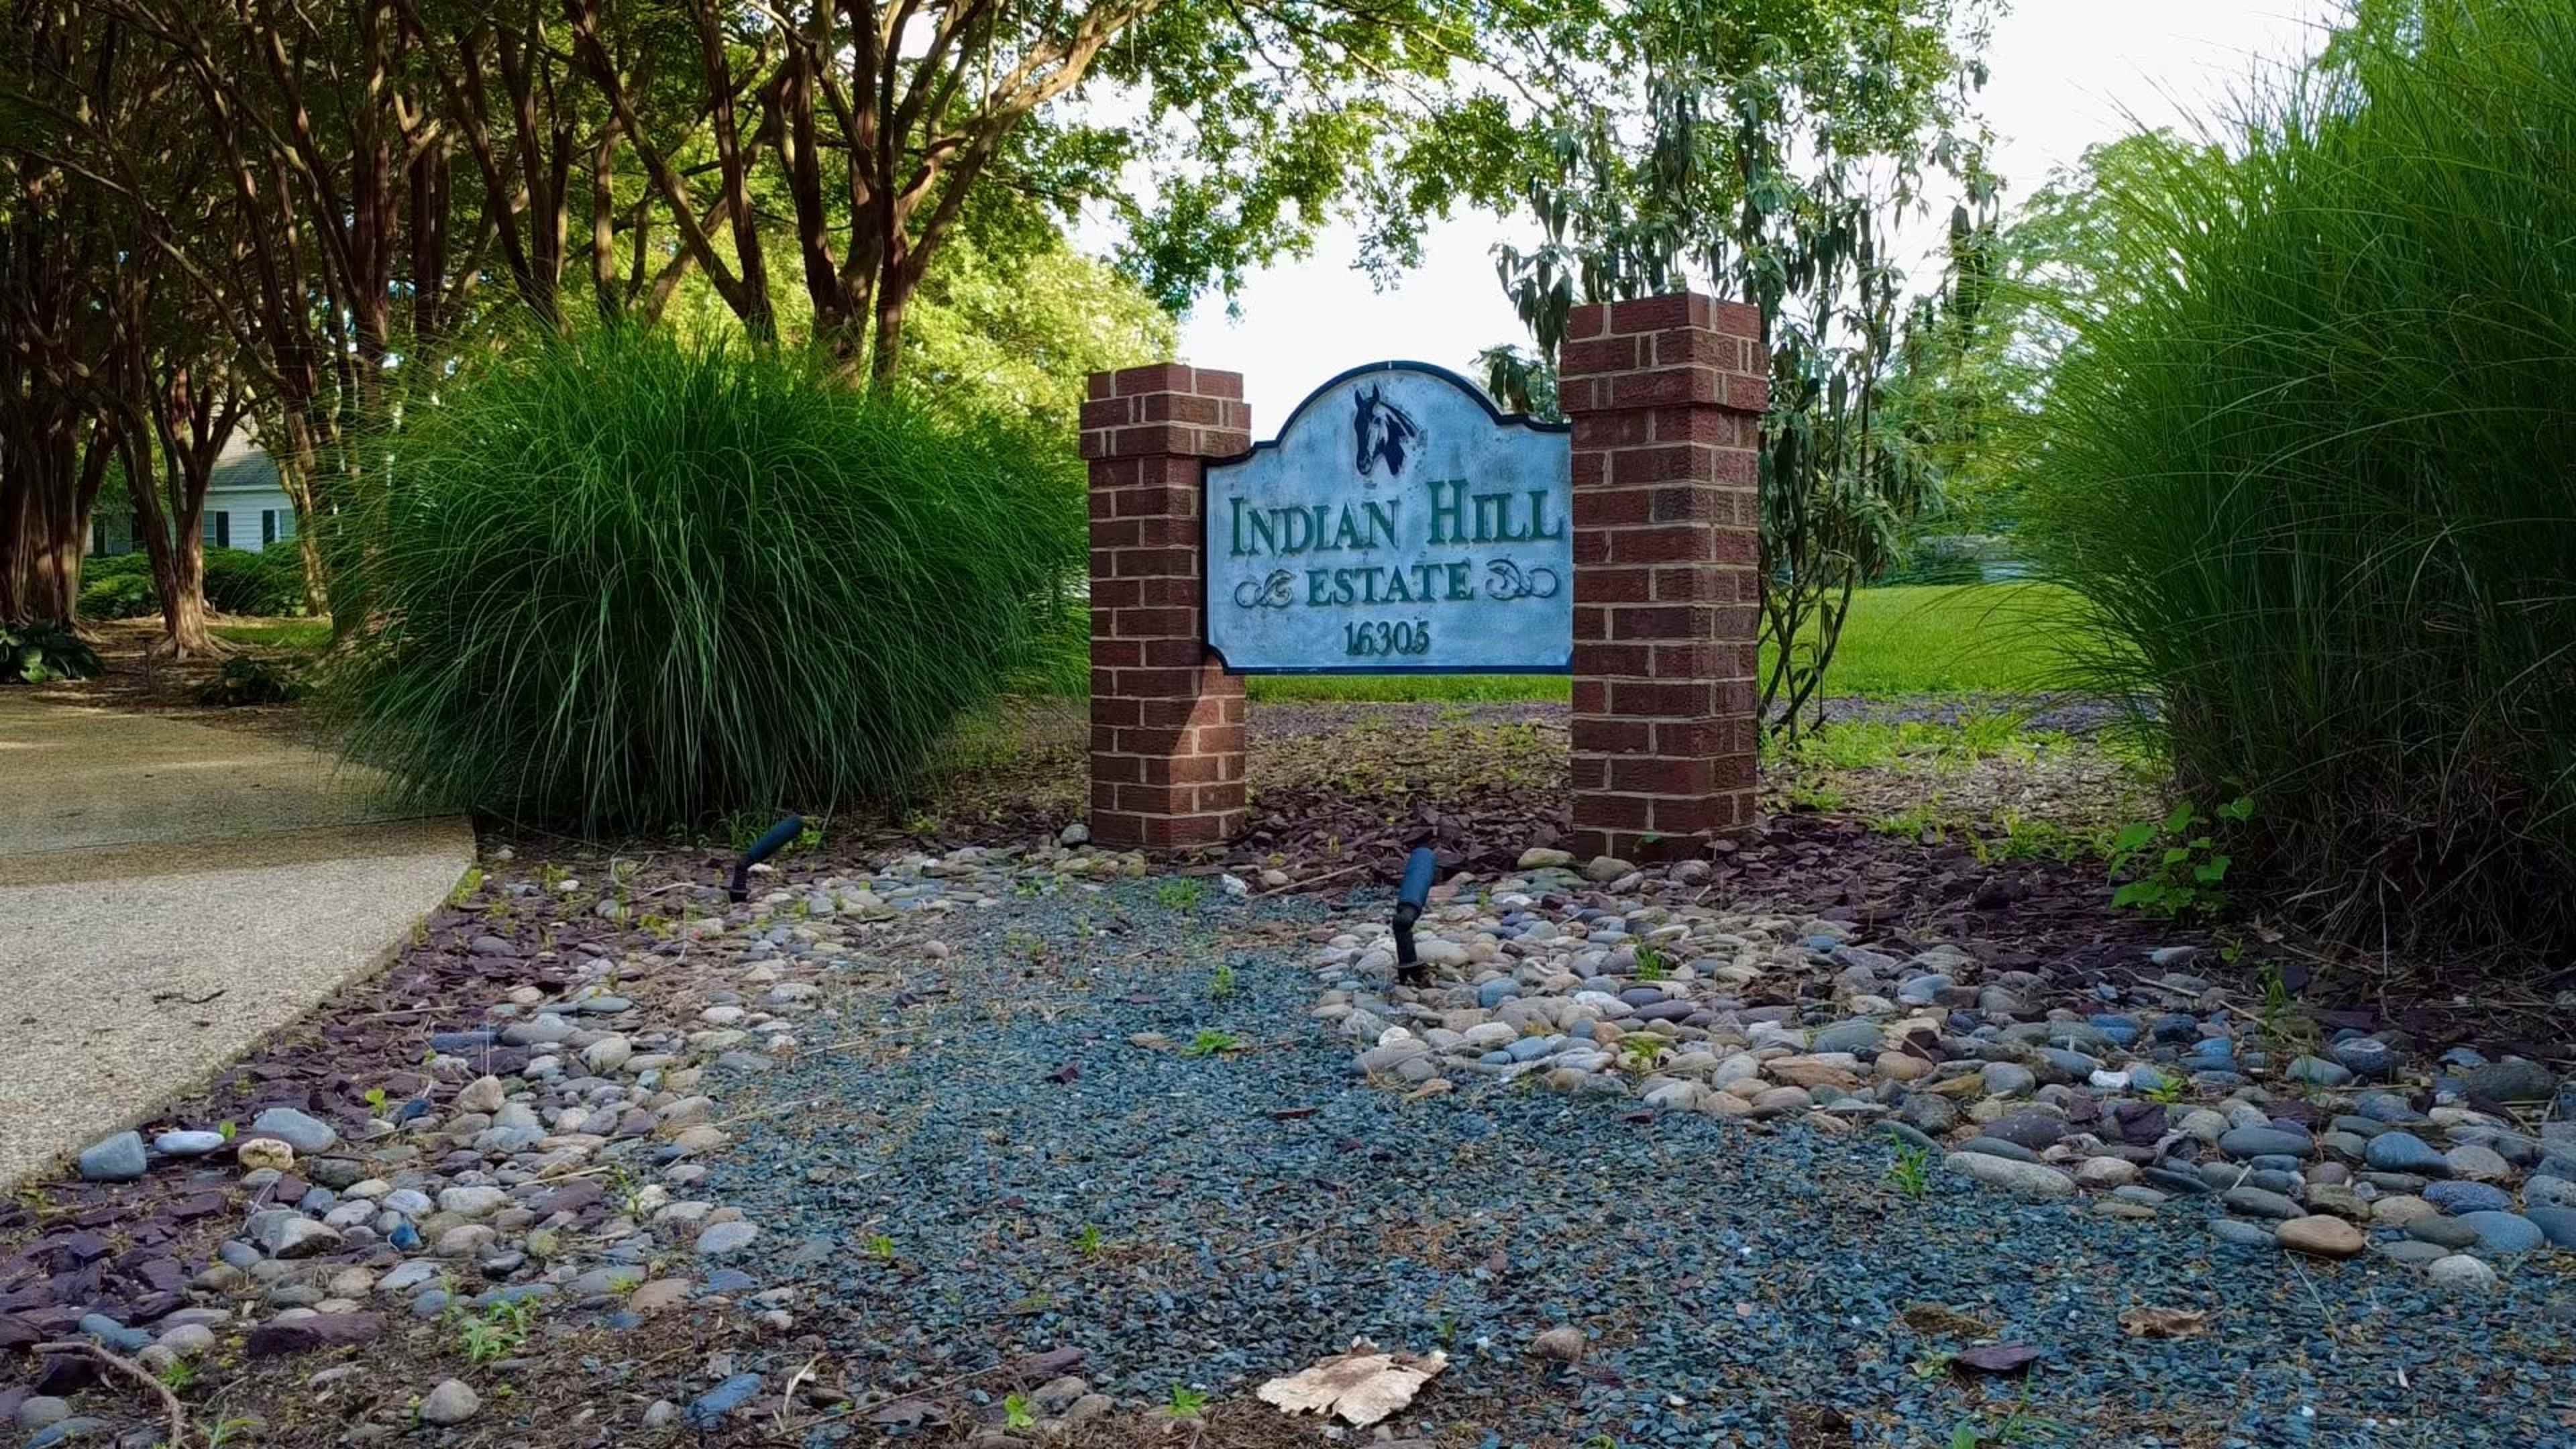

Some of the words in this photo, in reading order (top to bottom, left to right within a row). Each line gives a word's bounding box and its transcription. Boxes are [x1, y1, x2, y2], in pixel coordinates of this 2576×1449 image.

[1228, 496, 1401, 558] INDIAN
[1427, 478, 1564, 545] HILL
[1305, 562, 1474, 606] ESTATE
[1344, 621, 1430, 656] 16305
